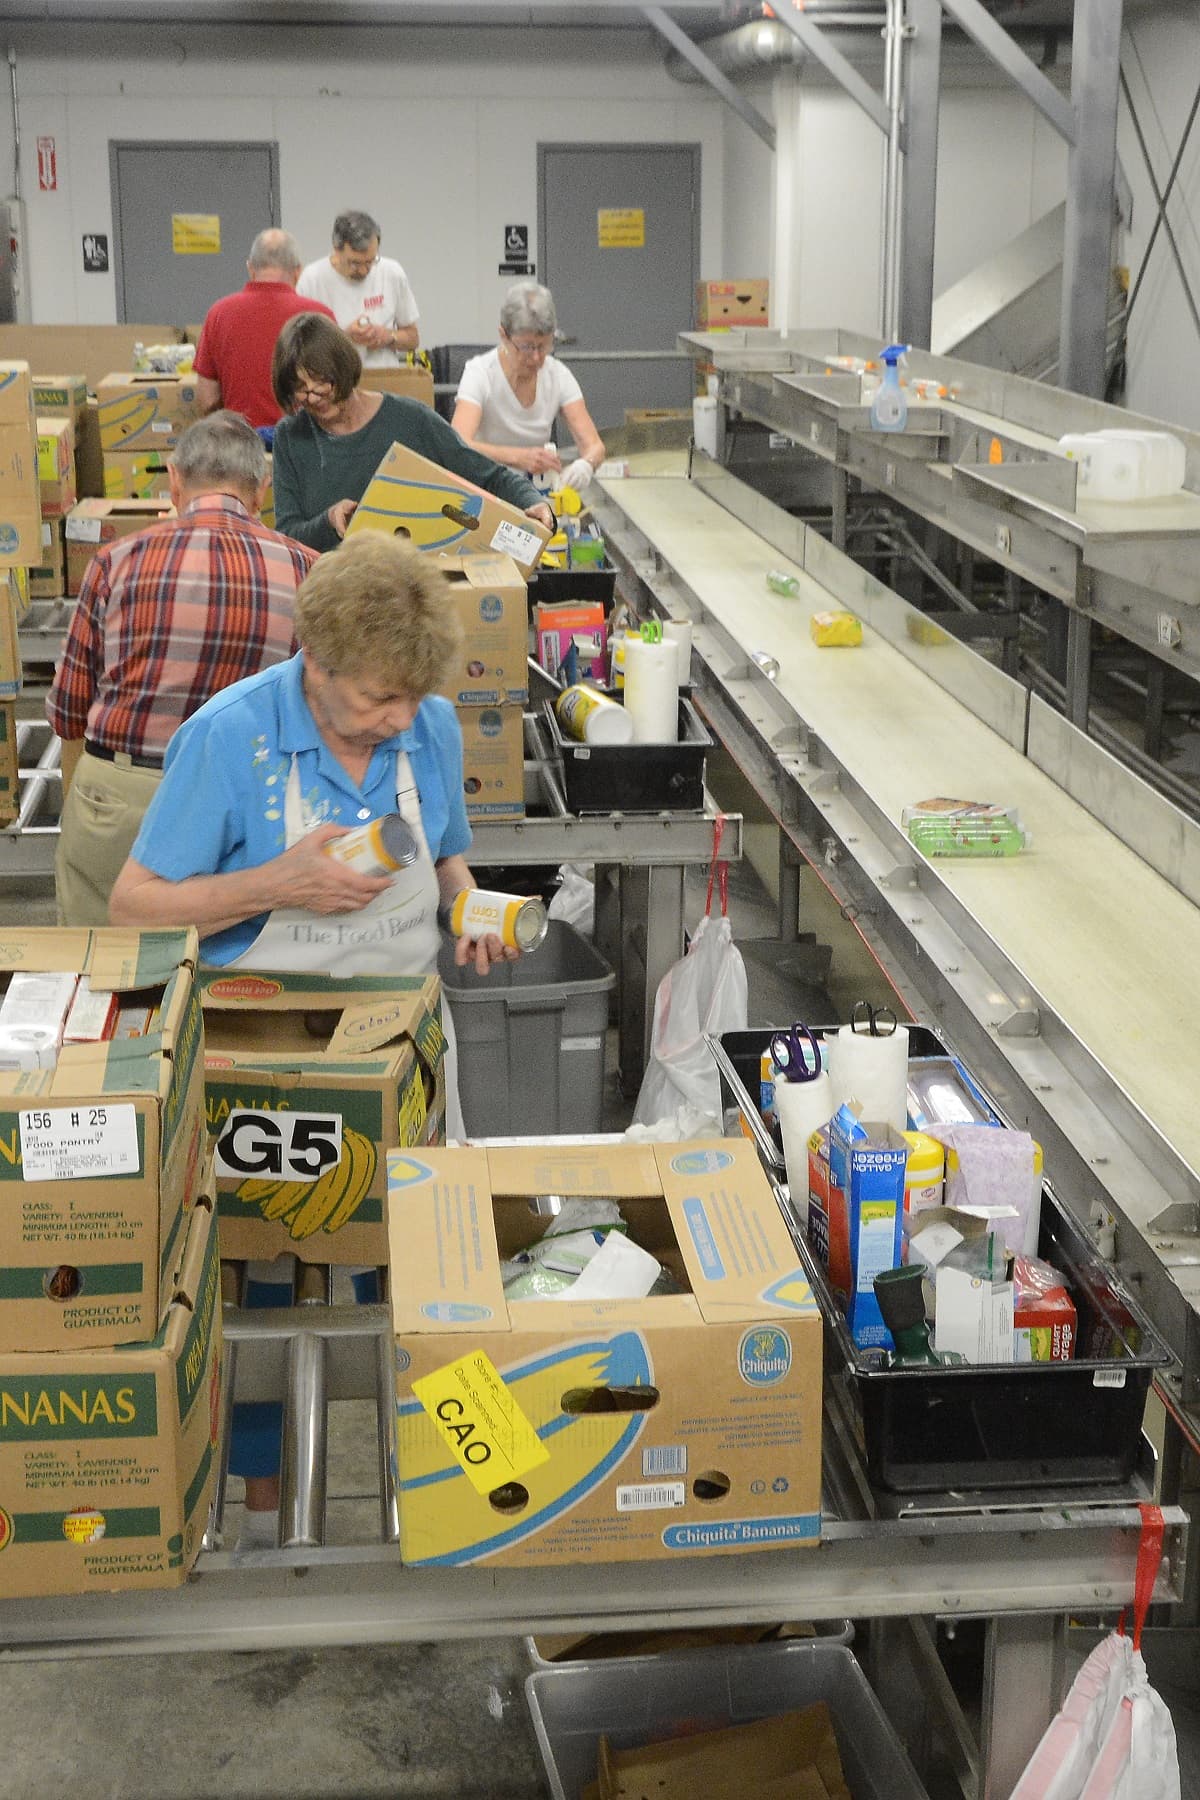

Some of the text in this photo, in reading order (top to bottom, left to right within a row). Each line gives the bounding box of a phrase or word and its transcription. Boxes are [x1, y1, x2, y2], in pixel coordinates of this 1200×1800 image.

[287, 923, 331, 945] The
[335, 920, 385, 946] Food
[25, 1111, 52, 1130] 156
[88, 1108, 107, 1127] 25
[26, 1138, 101, 1149] FOOD PANTRY
[217, 1113, 339, 1177] G5
[852, 1163, 893, 1173] GALLON
[63, 1304, 142, 1319] PRODUCT OF
[63, 1315, 142, 1329] GUATEMALA
[742, 1356, 788, 1377] Chiquita
[0, 1387, 137, 1426] NANAS
[436, 1398, 492, 1465] CAO
[675, 1527, 737, 1546] Chiquita
[742, 1523, 801, 1539] Bananas
[83, 1552, 164, 1566] PRODUCT OF
[88, 1563, 164, 1576] GUATEMALA
